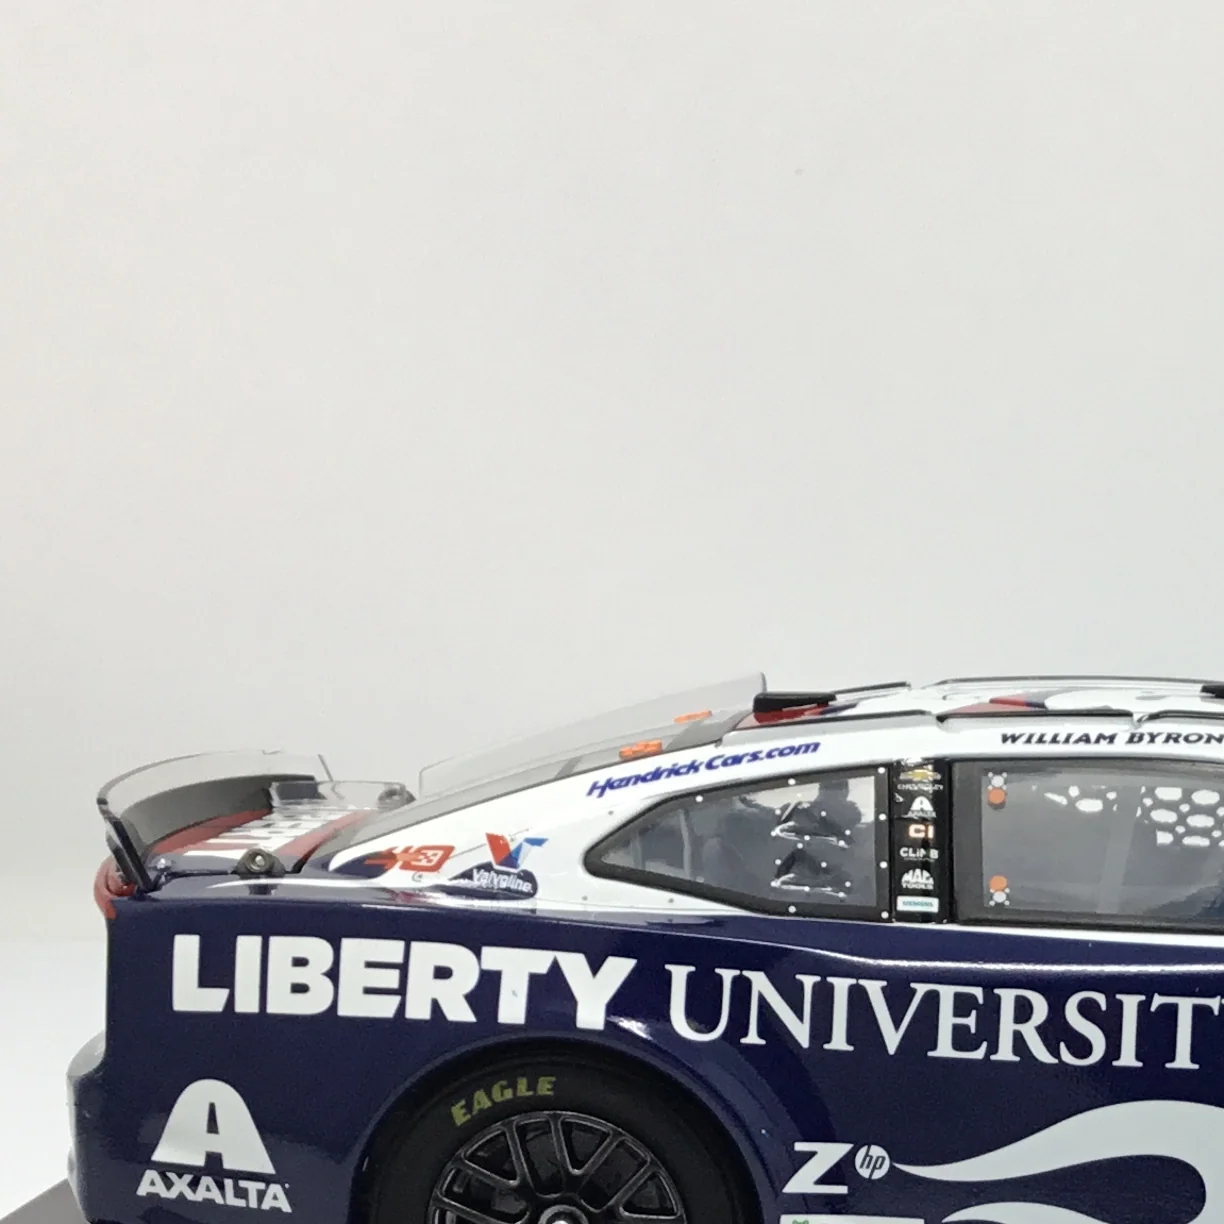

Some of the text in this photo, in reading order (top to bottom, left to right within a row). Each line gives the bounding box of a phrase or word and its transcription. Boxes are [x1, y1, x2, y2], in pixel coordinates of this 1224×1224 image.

[1001, 731, 1117, 746] WILLIAM
[171, 933, 637, 1031] LIBERTY
[451, 1075, 557, 1127] EAGLE
[136, 1169, 293, 1214] AXALTA
[782, 1141, 854, 1194] Z
